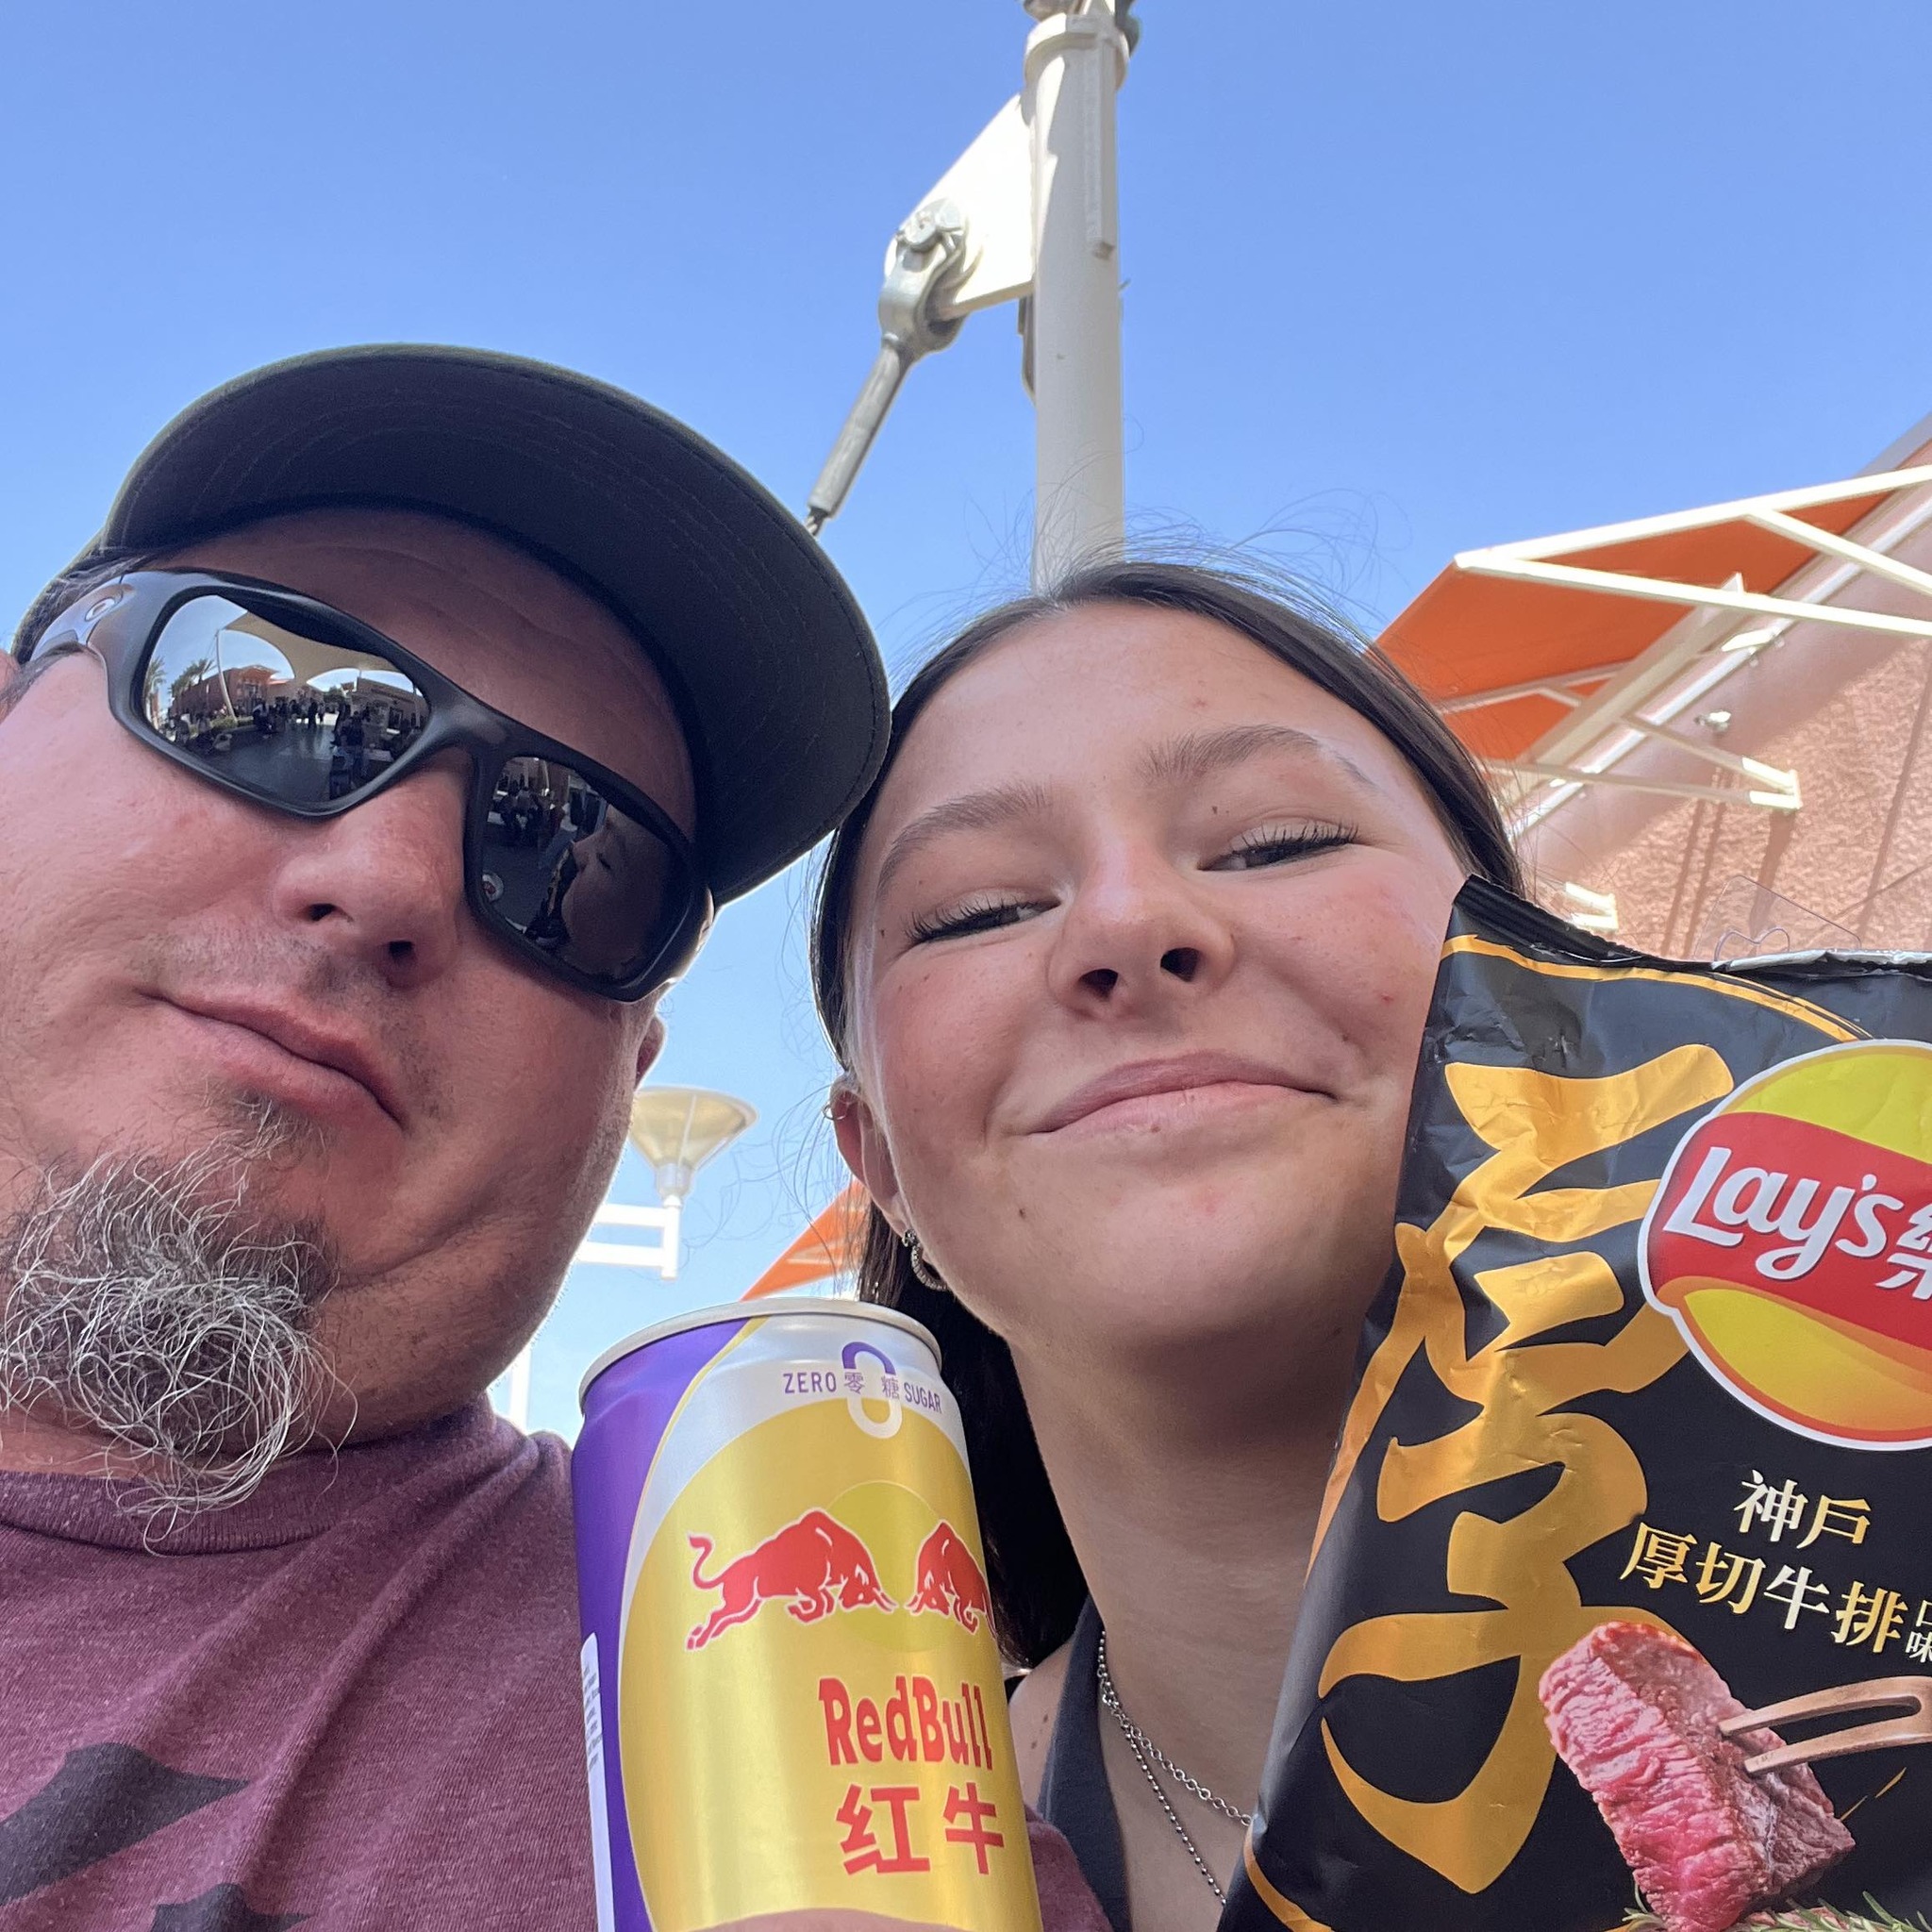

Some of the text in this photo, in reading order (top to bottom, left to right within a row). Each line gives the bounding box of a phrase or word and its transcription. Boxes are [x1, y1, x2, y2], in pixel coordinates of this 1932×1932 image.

[1663, 1146, 1905, 1280] Lay's
[783, 1372, 837, 1393] ZERO
[903, 1381, 942, 1414] SUGAR
[1619, 1522, 1908, 1653] 厚切牛排
[836, 1782, 1005, 1876] 红牛
